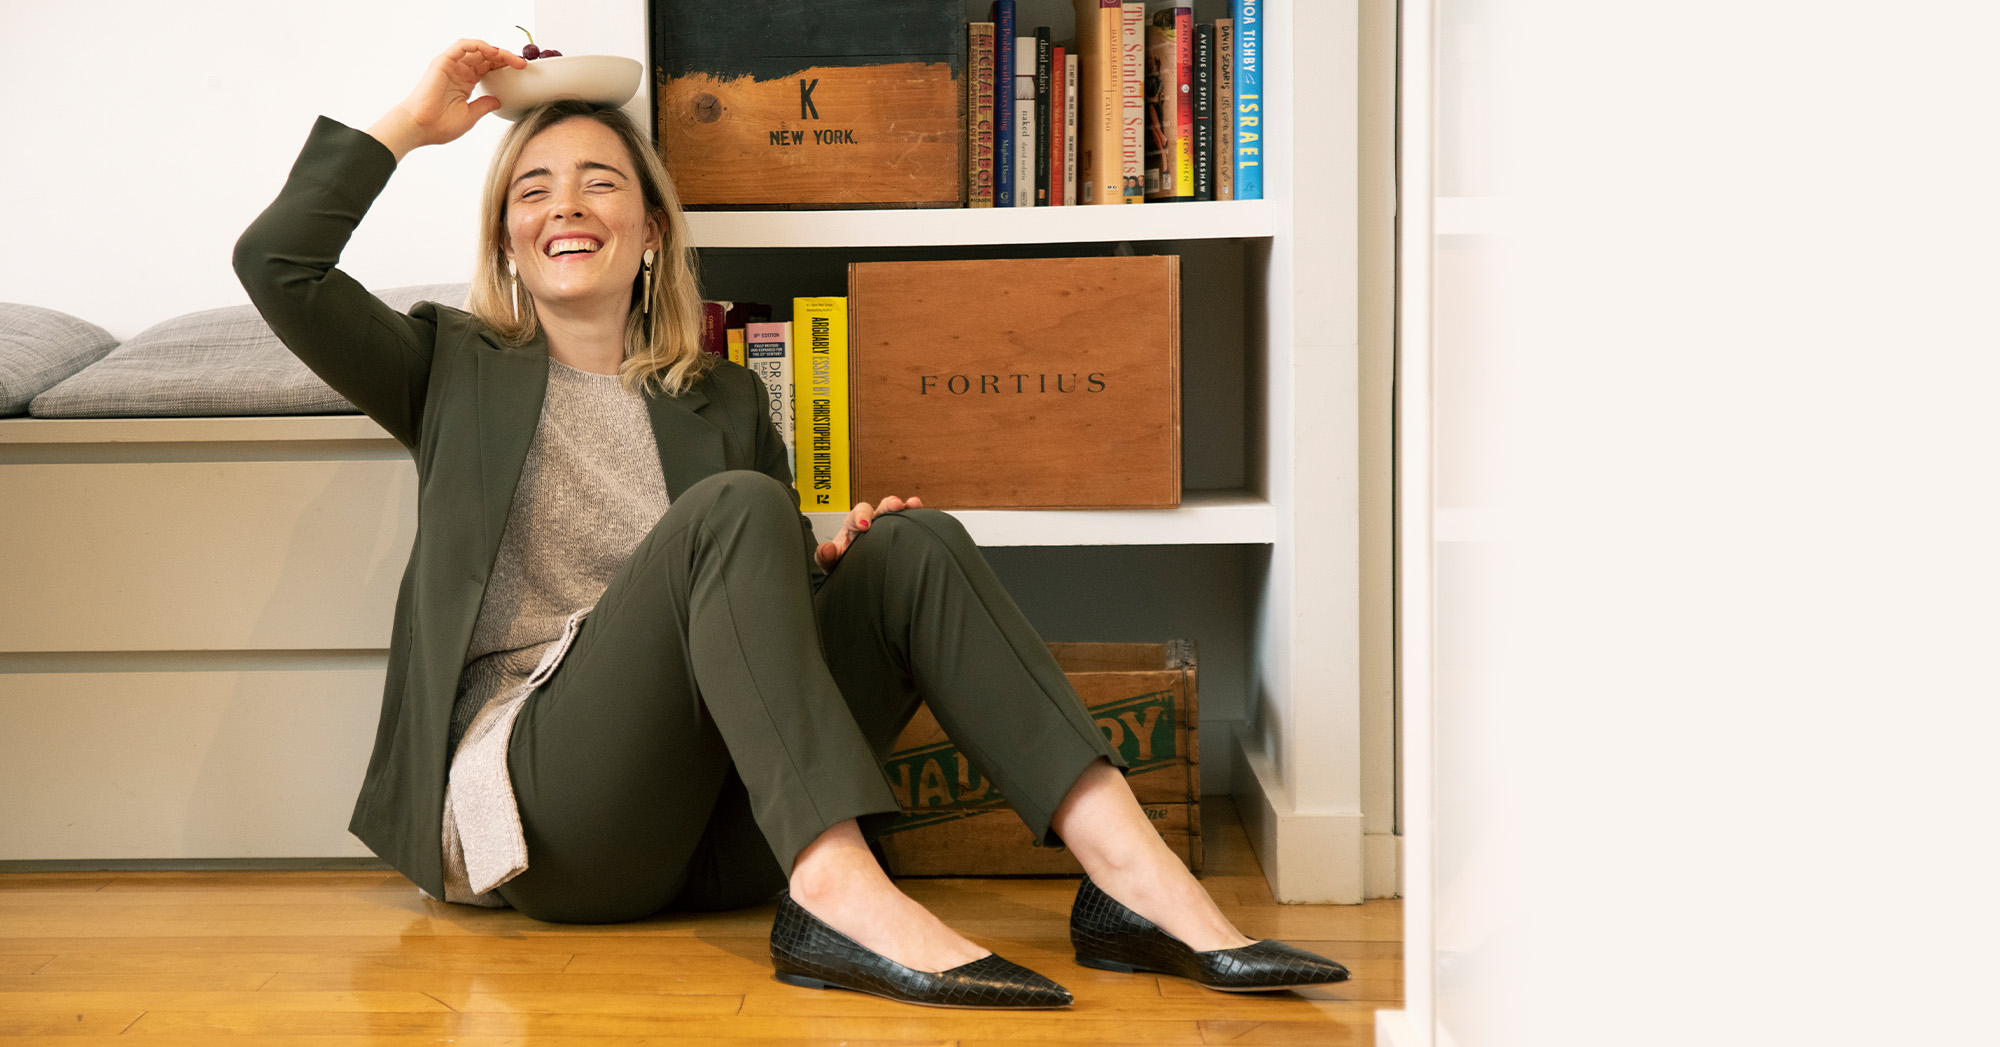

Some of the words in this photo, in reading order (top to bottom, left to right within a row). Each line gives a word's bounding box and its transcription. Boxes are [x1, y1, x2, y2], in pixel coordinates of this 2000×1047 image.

[1002, 8, 1012, 26] The
[1122, 6, 1143, 35] The
[1243, 0, 1256, 24] NOA
[1002, 28, 1012, 63] Problem
[1040, 39, 1049, 63] david
[1199, 33, 1207, 68] AVENUE
[1221, 25, 1230, 52] DAVID
[1243, 30, 1256, 72] TISHBY
[978, 34, 993, 115] MICHAEL
[1002, 65, 1011, 84] with
[1040, 65, 1049, 94] sedaris
[1122, 44, 1143, 109] Seinfeld
[1199, 72, 1207, 83] OF
[1221, 53, 1231, 90] SEDARIS
[799, 78, 820, 120] K
[1000, 86, 1011, 131] Everything
[1199, 87, 1207, 112] SPIES
[769, 130, 804, 146] NEW
[813, 129, 858, 146] YORK.
[1021, 110, 1031, 137] naked
[1199, 125, 1207, 147] ALEX
[1239, 94, 1259, 169] ISRAEL
[977, 120, 993, 198] CHABON
[1001, 139, 1009, 164] Meghan
[1122, 117, 1143, 174] Scripts
[1199, 151, 1207, 193] KERSHAW
[811, 317, 829, 354] ARGUABLY
[760, 361, 768, 380] BABY
[769, 361, 781, 381] DR.
[812, 356, 830, 385] ESSAYS
[920, 372, 1107, 396] FORTIUS
[812, 386, 830, 397] BY
[812, 399, 831, 452] CHRISTOPHER
[813, 452, 831, 490] HITCHENS
